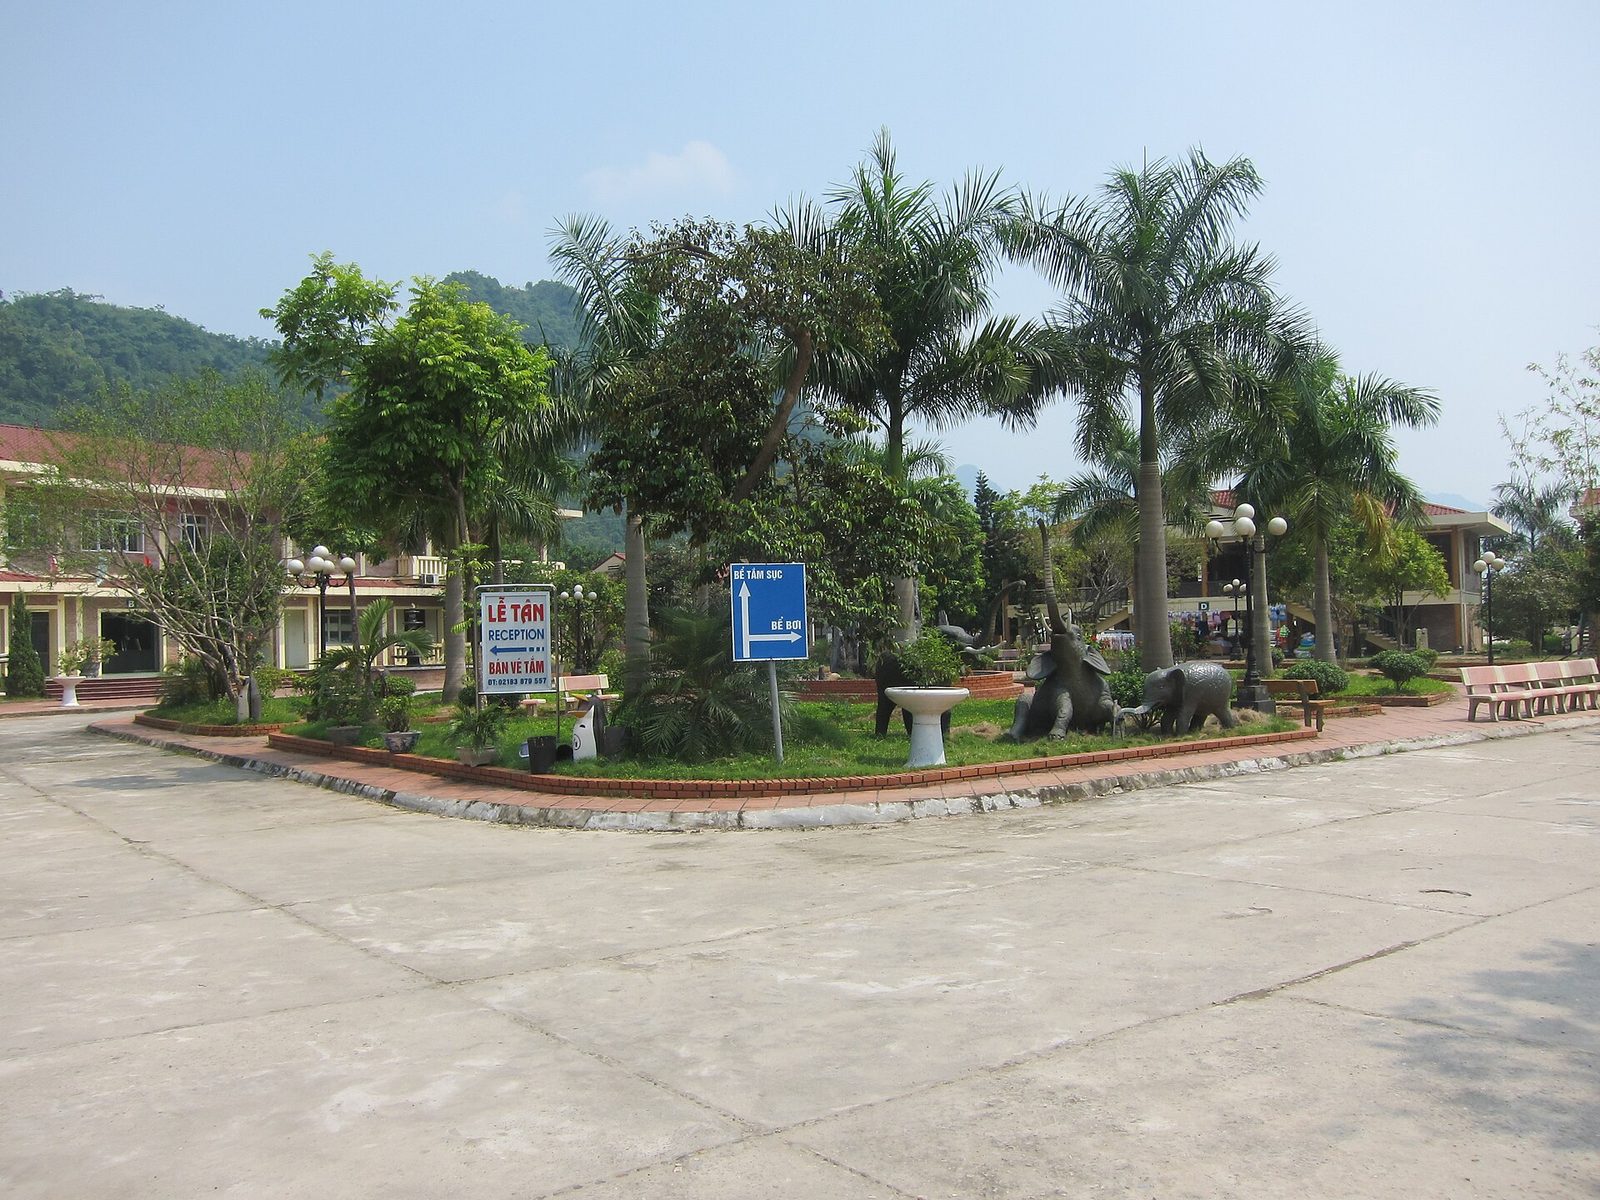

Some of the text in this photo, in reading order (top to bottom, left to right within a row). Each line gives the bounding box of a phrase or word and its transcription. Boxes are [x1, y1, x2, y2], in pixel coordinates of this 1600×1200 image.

[766, 570, 782, 580] SỤC
[488, 596, 544, 624] LỄ TÂN
[786, 620, 801, 630] BƠI
[488, 628, 544, 640] RECEPTION
[489, 656, 544, 674] BÁN VÉ TẮM
